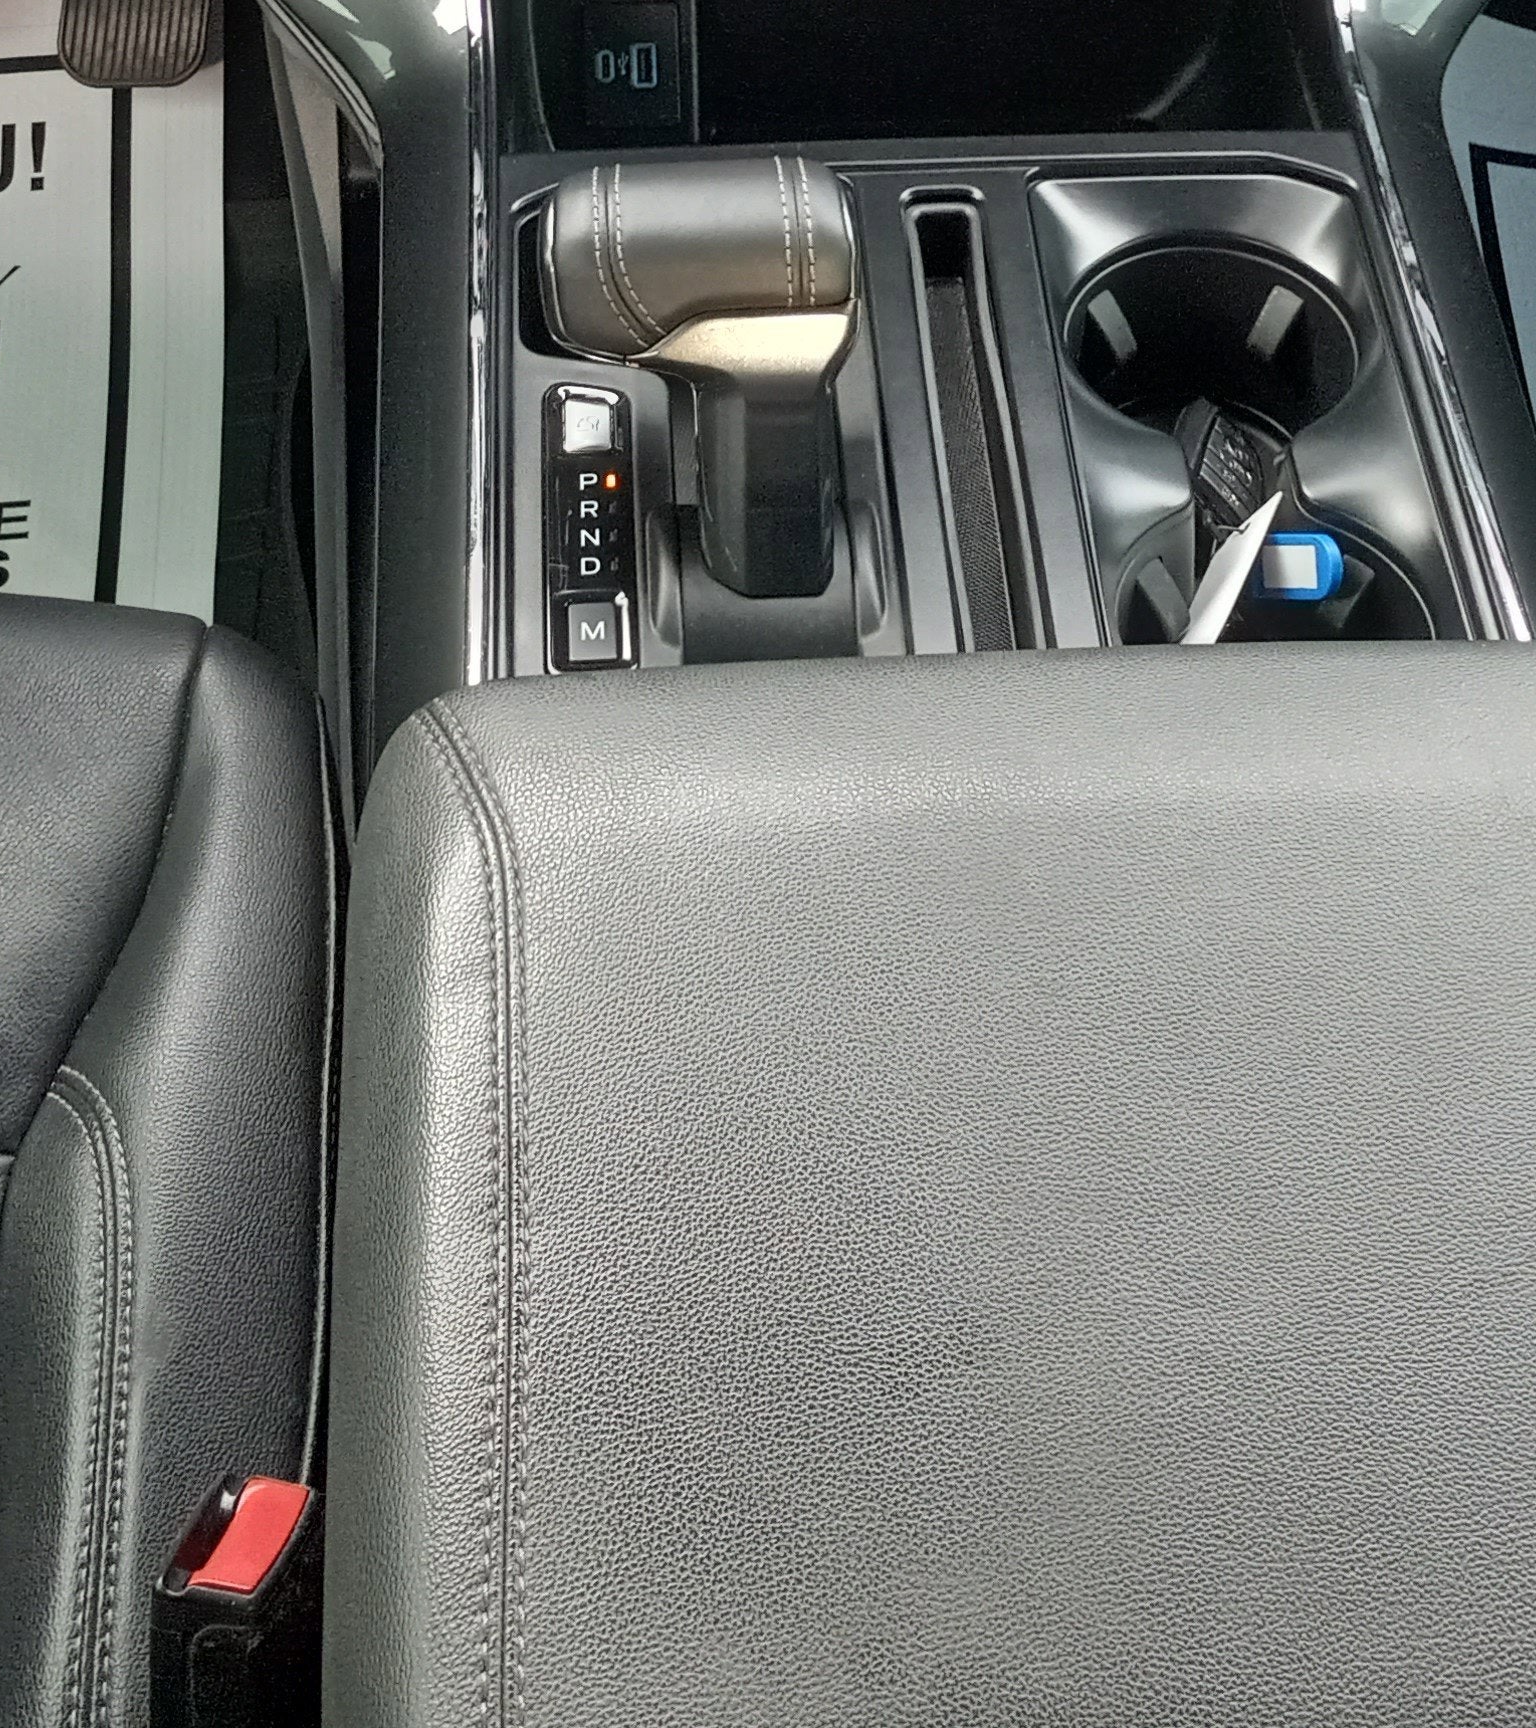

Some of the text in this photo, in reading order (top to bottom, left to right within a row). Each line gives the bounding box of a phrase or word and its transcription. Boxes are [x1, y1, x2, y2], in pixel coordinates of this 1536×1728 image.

[579, 473, 598, 491] P
[580, 500, 599, 519] R
[580, 528, 600, 547] N
[580, 557, 601, 575] D
[580, 621, 605, 640] M
